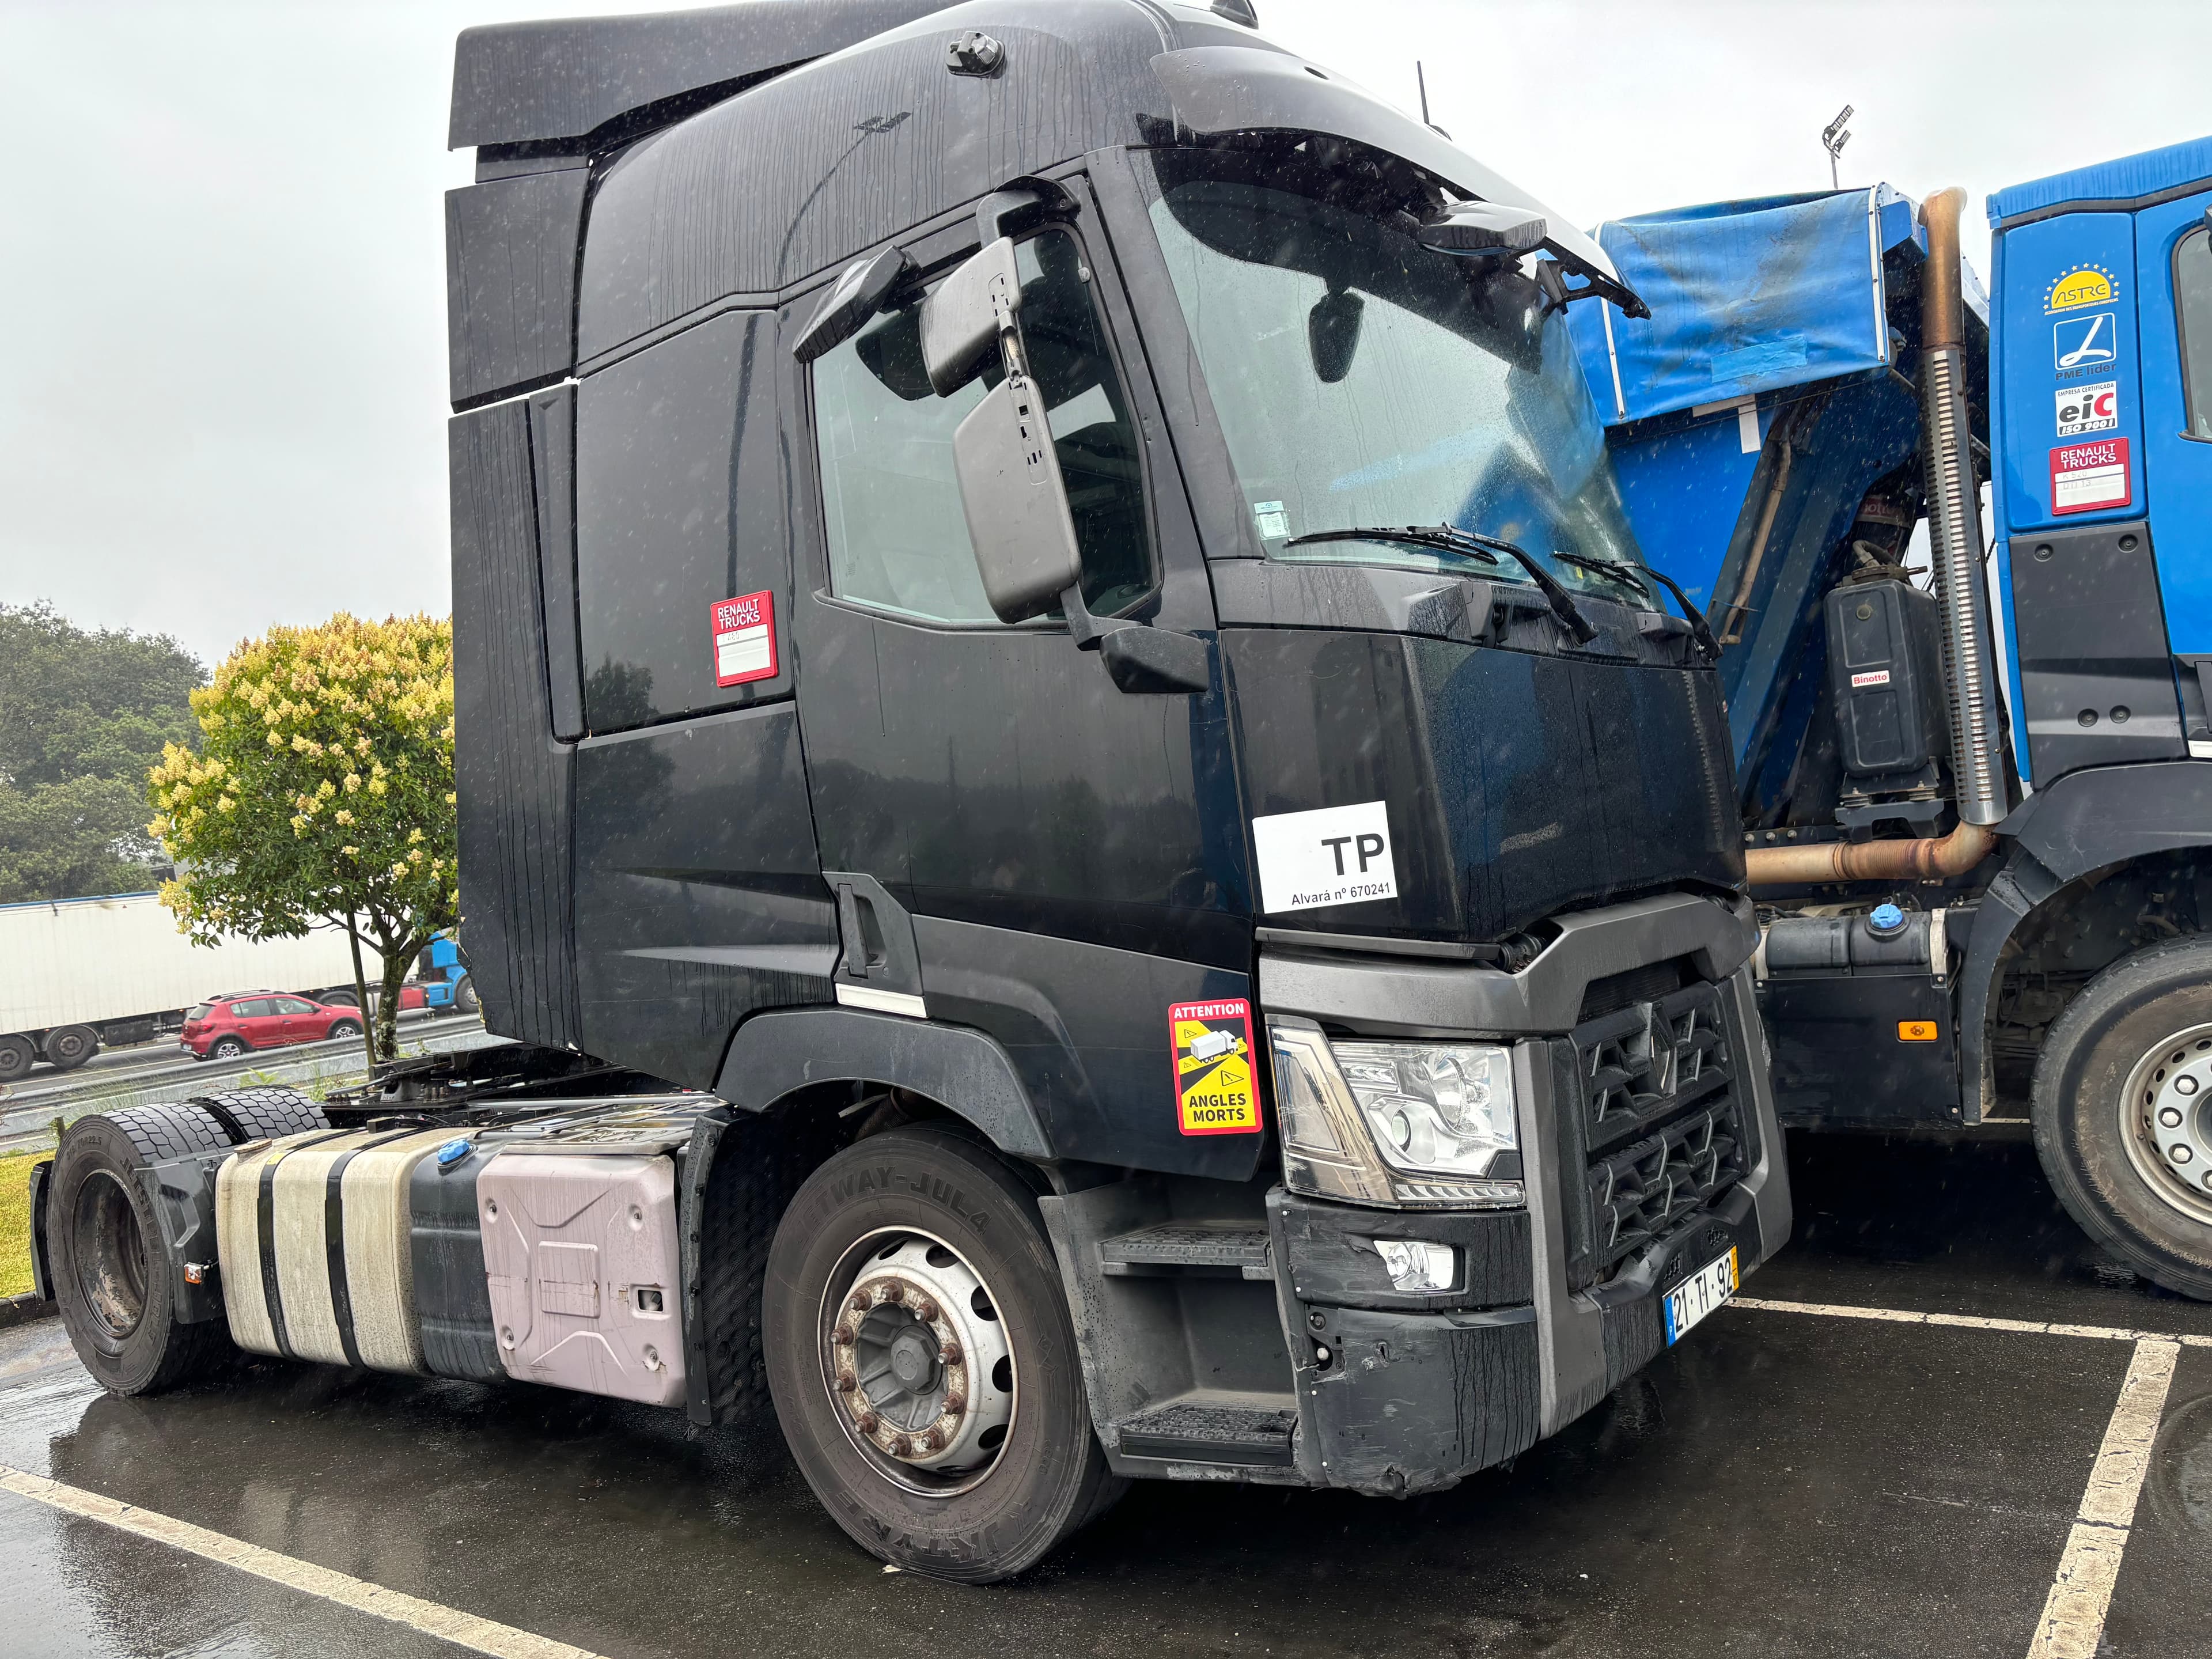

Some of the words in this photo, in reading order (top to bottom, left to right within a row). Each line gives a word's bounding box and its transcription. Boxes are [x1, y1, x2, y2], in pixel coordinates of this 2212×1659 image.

[2055, 283, 2106, 304] ASTRE
[2055, 369, 2083, 380] PME
[2058, 388, 2081, 396] EMPRESA
[2082, 382, 2114, 392] CERTIFICADA
[2062, 424, 2082, 434] ISO
[2085, 419, 2113, 430] 9001
[2061, 444, 2115, 461] RENAULT
[2061, 453, 2116, 469] TRUCKS
[718, 599, 759, 619] RENAULT
[719, 611, 760, 630] TRUCKS
[1854, 673, 1887, 684] Binotto
[1321, 833, 1384, 876] TP
[1291, 890, 1331, 905] Alvará
[1350, 882, 1390, 897] 670241
[1174, 1003, 1244, 1019] ATTENTION
[1189, 1093, 1246, 1108] ANGLES
[1193, 1108, 1245, 1122] MORTS
